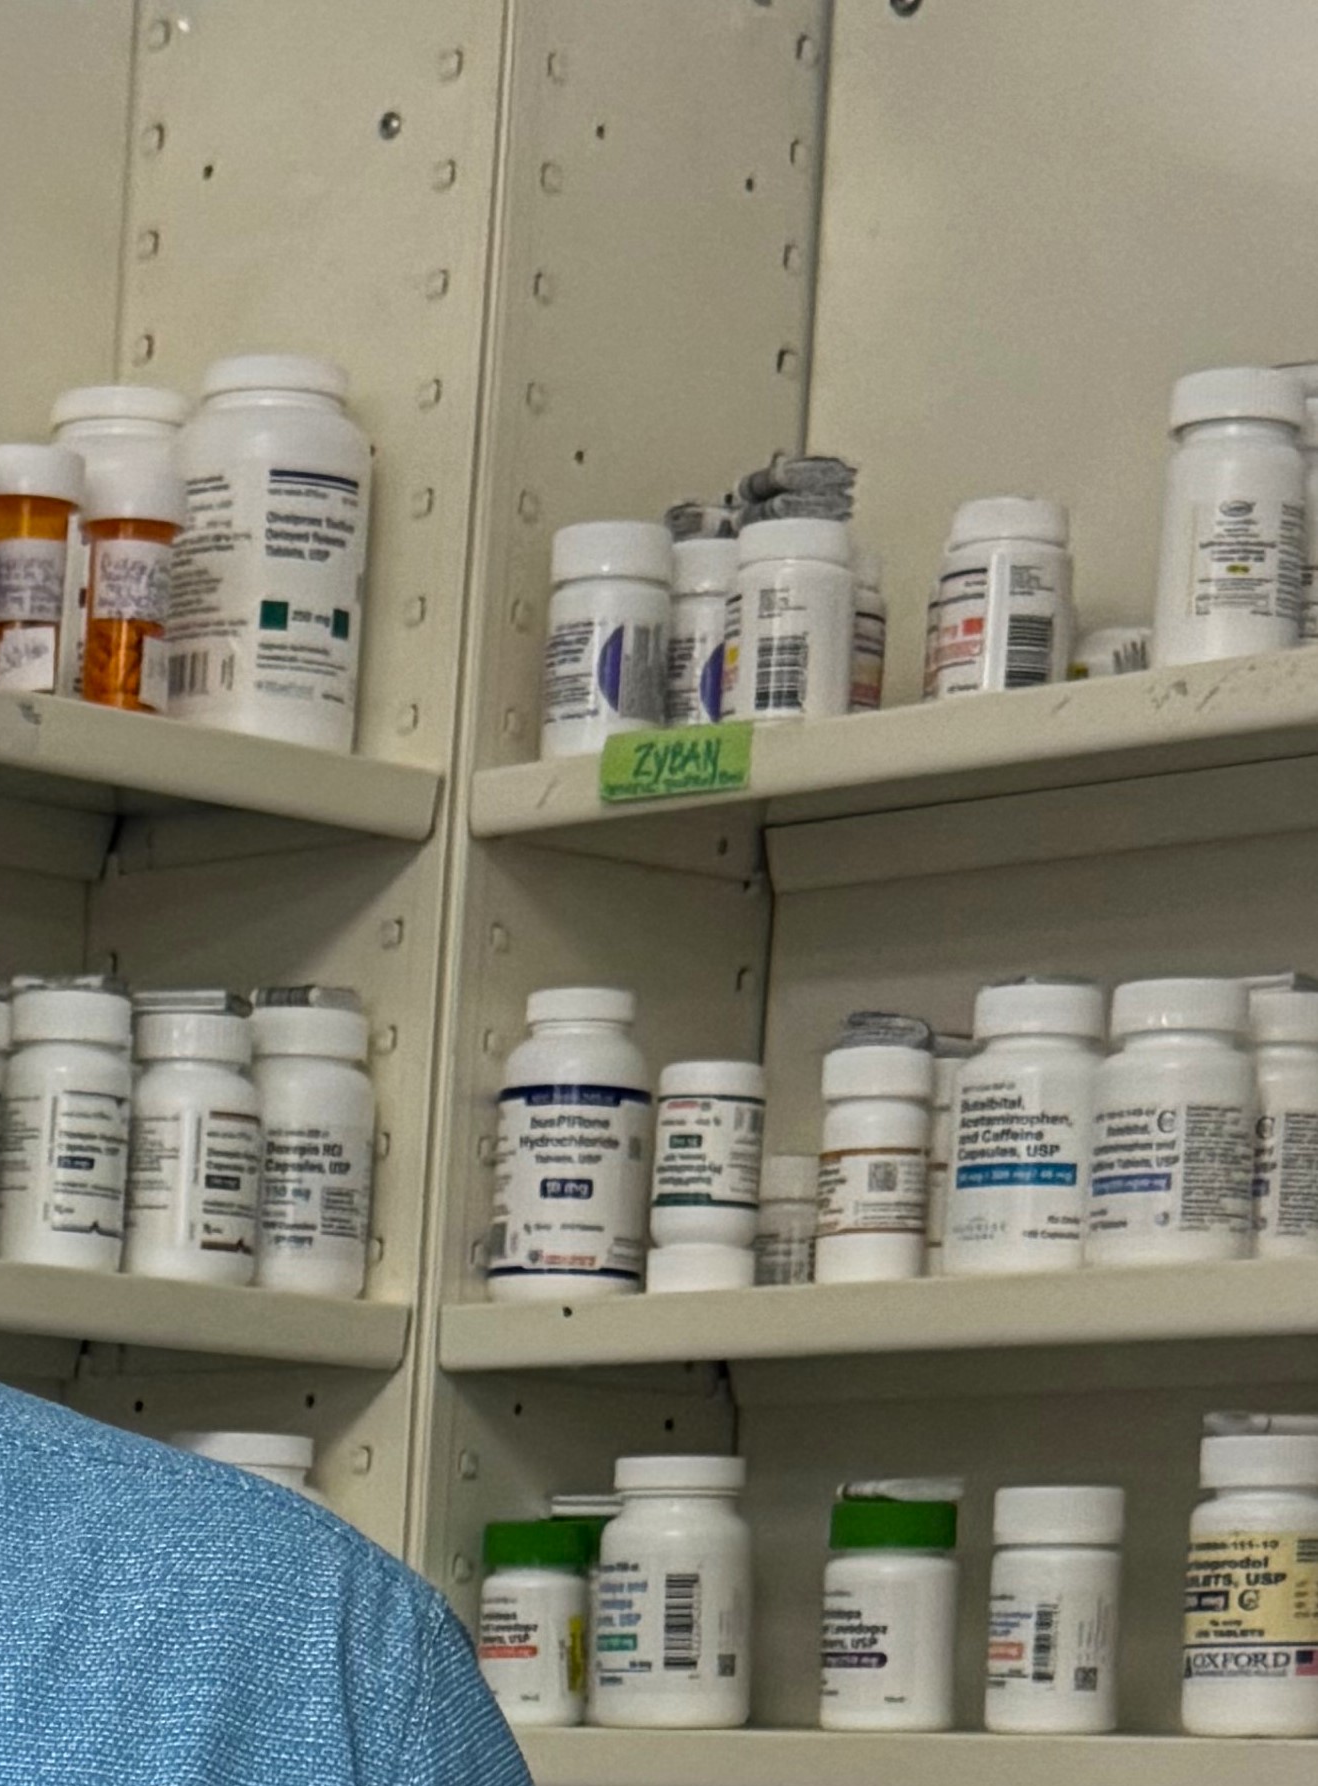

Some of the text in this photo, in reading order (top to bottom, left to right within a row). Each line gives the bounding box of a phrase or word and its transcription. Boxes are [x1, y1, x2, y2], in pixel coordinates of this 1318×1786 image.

[633, 739, 722, 784] ZYBAN
[960, 1111, 1073, 1129] Acetaminophen,
[519, 1135, 620, 1150] Hydrochloride
[981, 1127, 1045, 1143] Caffeine
[958, 1143, 1061, 1161] Capsules, USP
[1245, 1572, 1288, 1586] USP
[1193, 1652, 1292, 1669] OXFORD
